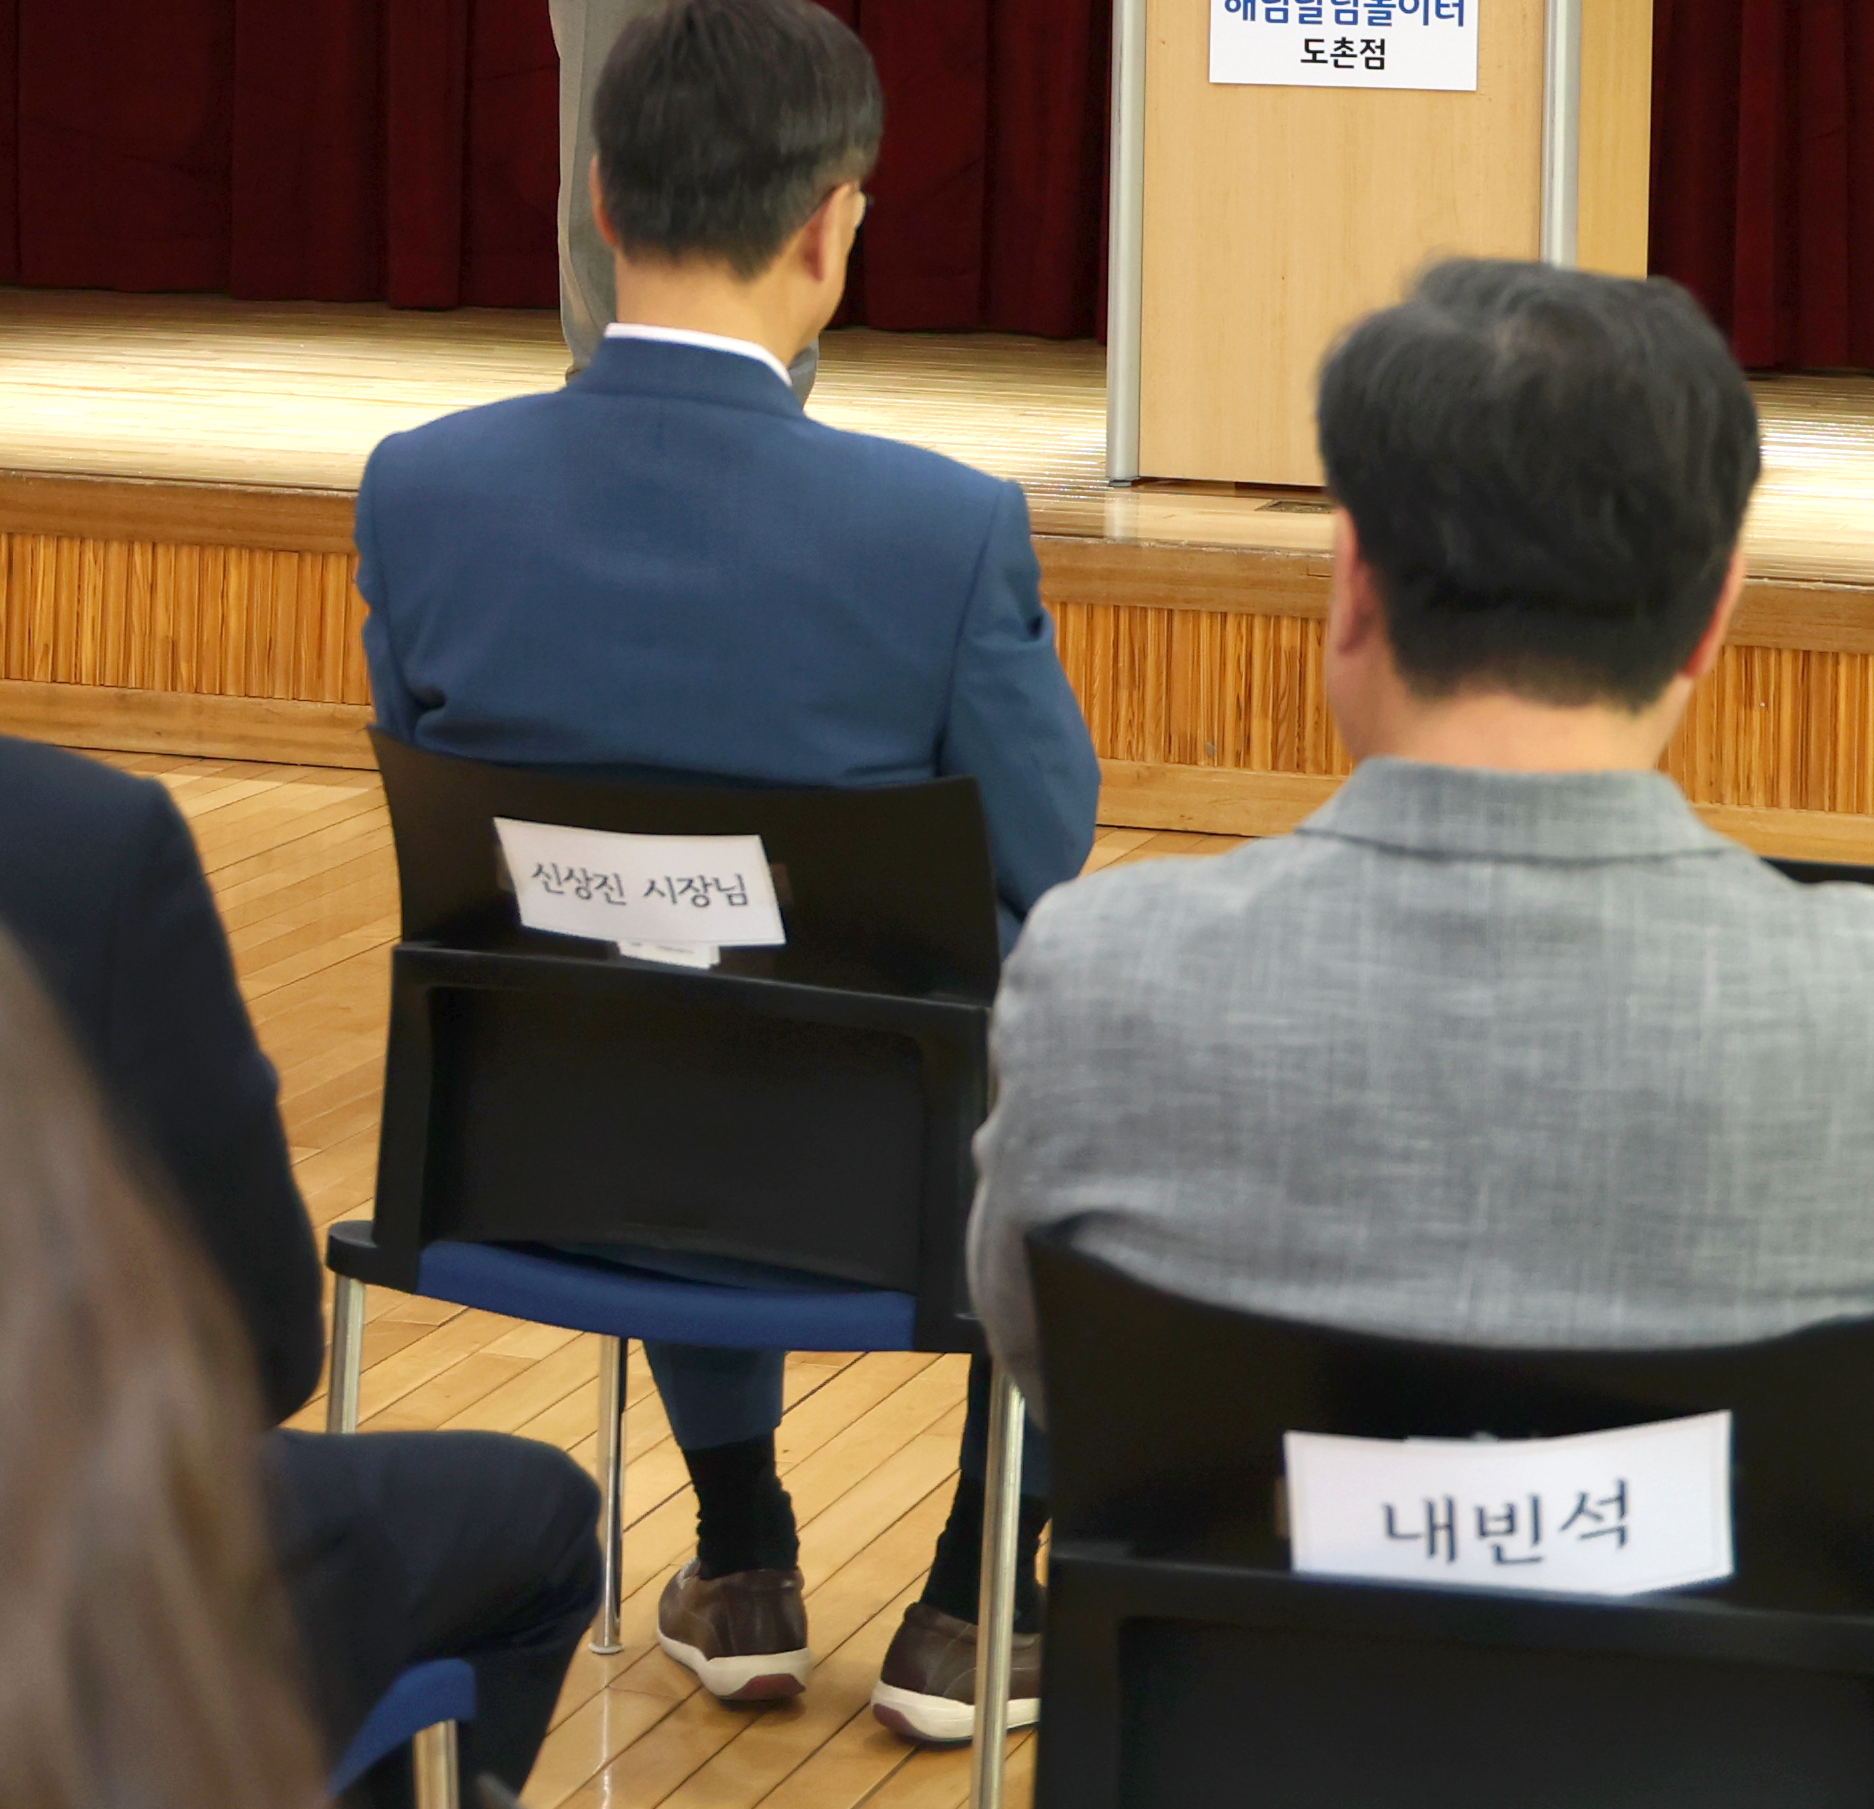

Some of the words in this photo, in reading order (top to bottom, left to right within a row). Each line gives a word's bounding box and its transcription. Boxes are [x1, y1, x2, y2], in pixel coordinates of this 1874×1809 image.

[1300, 36, 1387, 71] 도촌점
[530, 862, 626, 906] 신상진
[643, 873, 749, 908] 시장님
[1381, 1476, 1631, 1567] 내빈석
